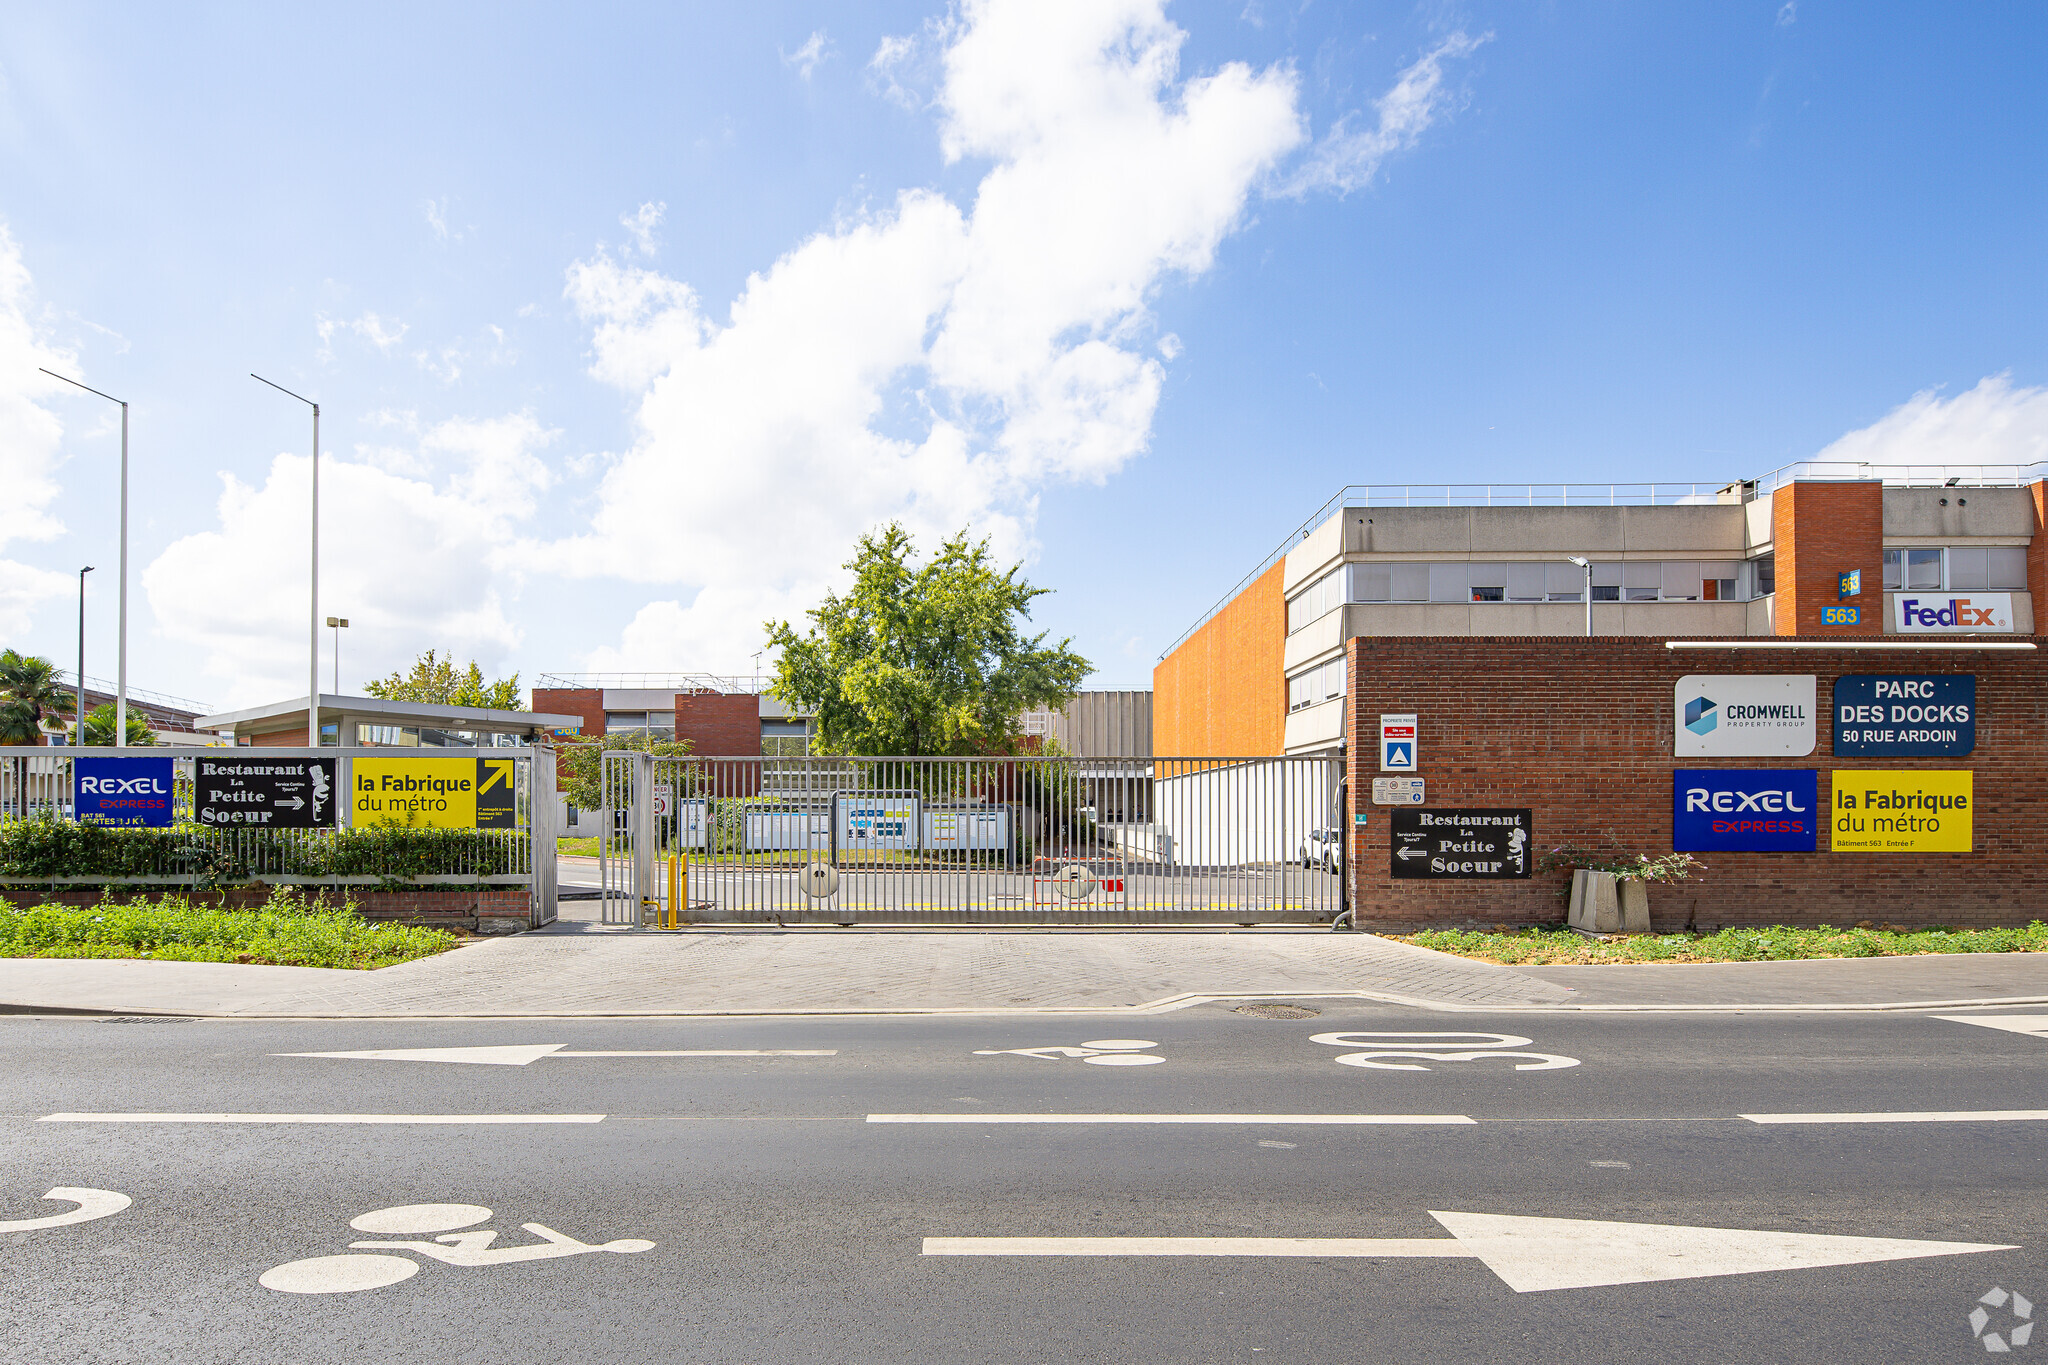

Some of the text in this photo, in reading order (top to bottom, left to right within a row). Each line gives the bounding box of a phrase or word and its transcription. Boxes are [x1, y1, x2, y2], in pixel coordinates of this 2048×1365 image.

[1841, 575, 1859, 593] 563
[1826, 608, 1857, 623] 563
[1875, 681, 1934, 699] PARC
[1727, 705, 1805, 719] CROMWELL
[1840, 705, 1969, 723] DES DOCKS
[1842, 730, 1957, 742] 50 RUE ARDOIN
[202, 763, 304, 776] Restaurant
[81, 776, 166, 794] REXEL
[358, 774, 471, 796] la Fabrique
[100, 799, 165, 808] EXPRESS
[209, 790, 265, 802] Petite
[358, 794, 447, 811] du métro
[1686, 788, 1806, 812] REXEL
[1837, 790, 1968, 814] la Fabrique
[201, 807, 272, 824] Soeur
[1419, 814, 1522, 826] Restaurant
[1837, 812, 1940, 832] du métro
[1712, 820, 1804, 832] EXPRESS
[1439, 840, 1494, 852] Petite
[1431, 857, 1502, 873] Soeur
